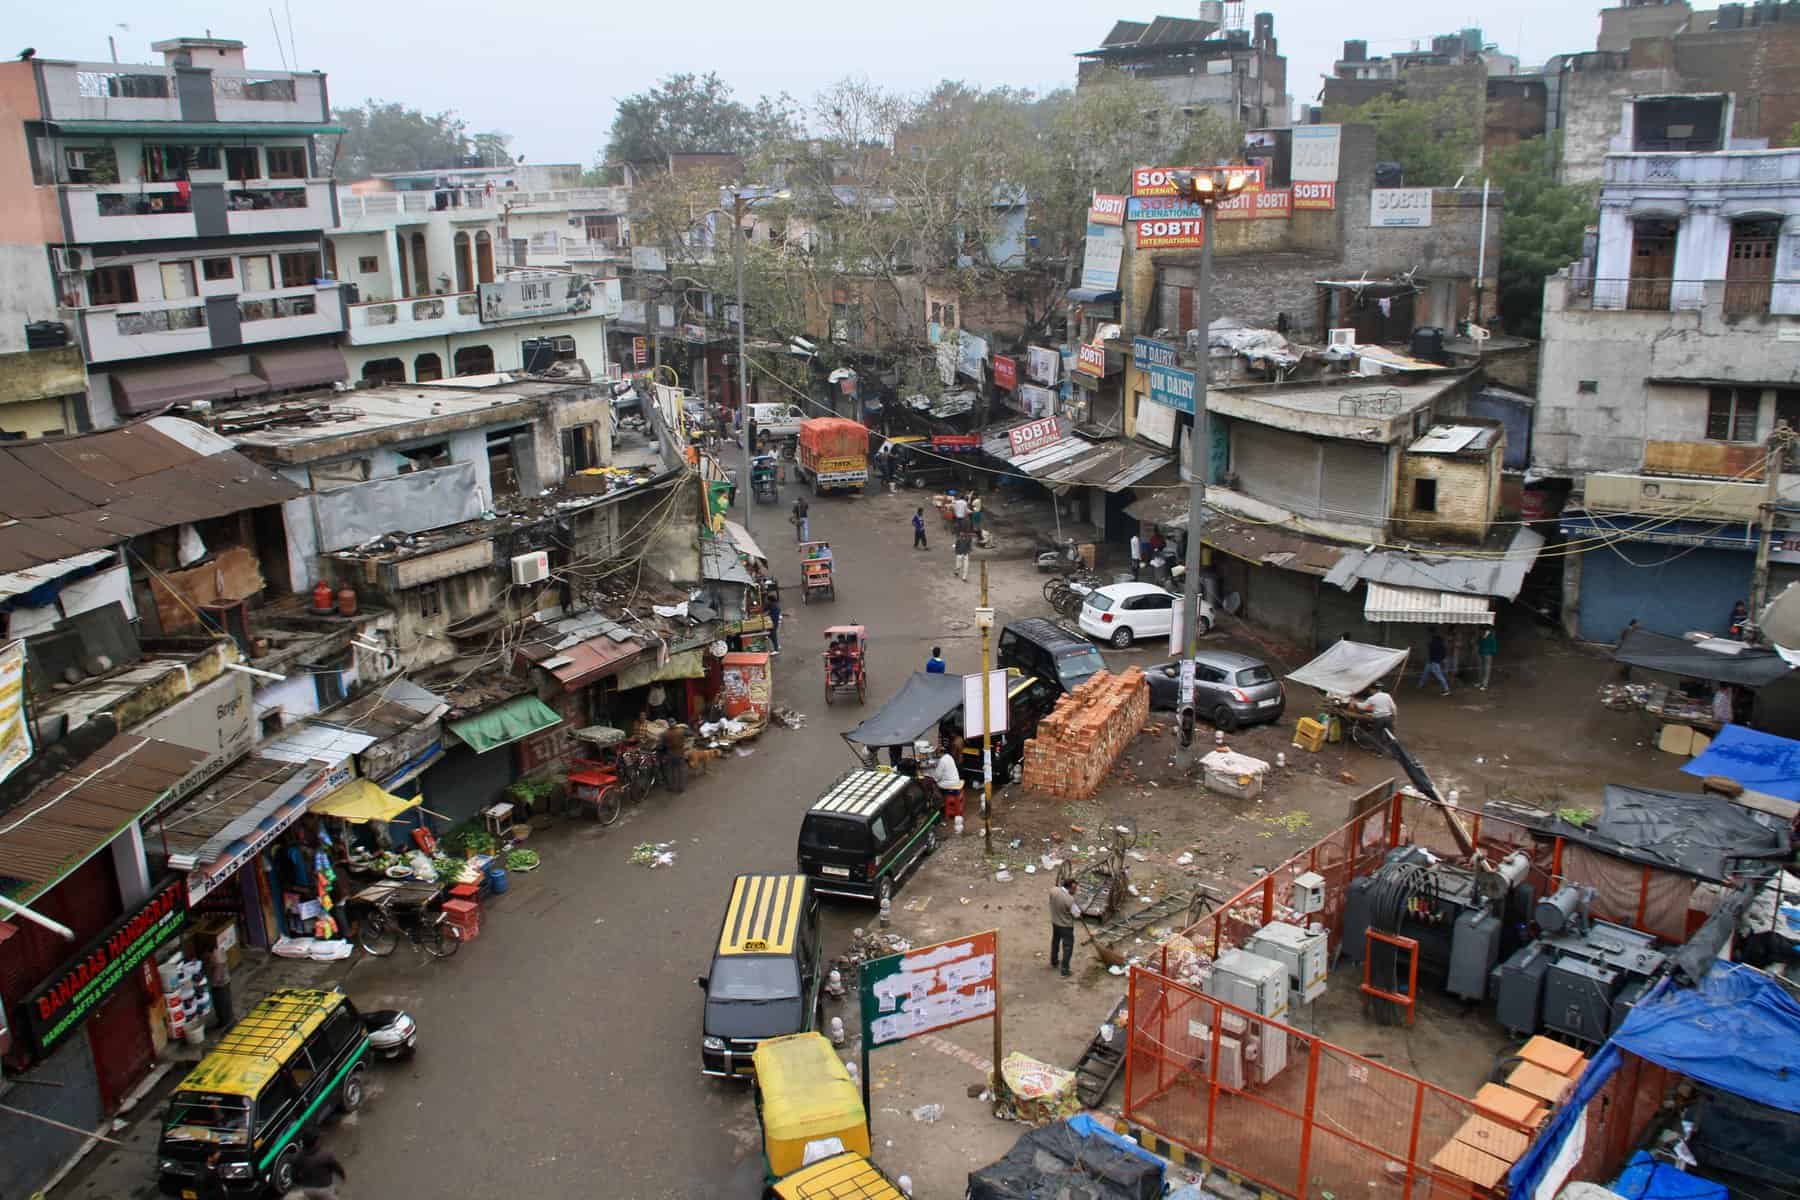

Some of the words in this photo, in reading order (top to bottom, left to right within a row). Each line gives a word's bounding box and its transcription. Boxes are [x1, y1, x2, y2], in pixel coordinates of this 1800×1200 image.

[1256, 192, 1289, 208] SOBTI
[1294, 183, 1332, 199] SOBTI
[1094, 198, 1122, 214] SOBTI
[1130, 208, 1200, 218] INTERNATIONAL
[1140, 221, 1201, 237] SOBTI
[1140, 236, 1200, 246] INTERNATIONAL
[1080, 347, 1104, 365] SOBTI
[1135, 343, 1147, 359] OM
[1149, 346, 1174, 367] DAIRY
[1151, 372, 1165, 391] OM
[1167, 375, 1193, 399] DAIRY
[1012, 418, 1057, 443] SOBTI
[1013, 431, 1060, 454] INTERNATIONAL
[178, 757, 225, 795] BROTHERS
[204, 858, 240, 892] PAINTS
[38, 948, 108, 1020] BANARAS
